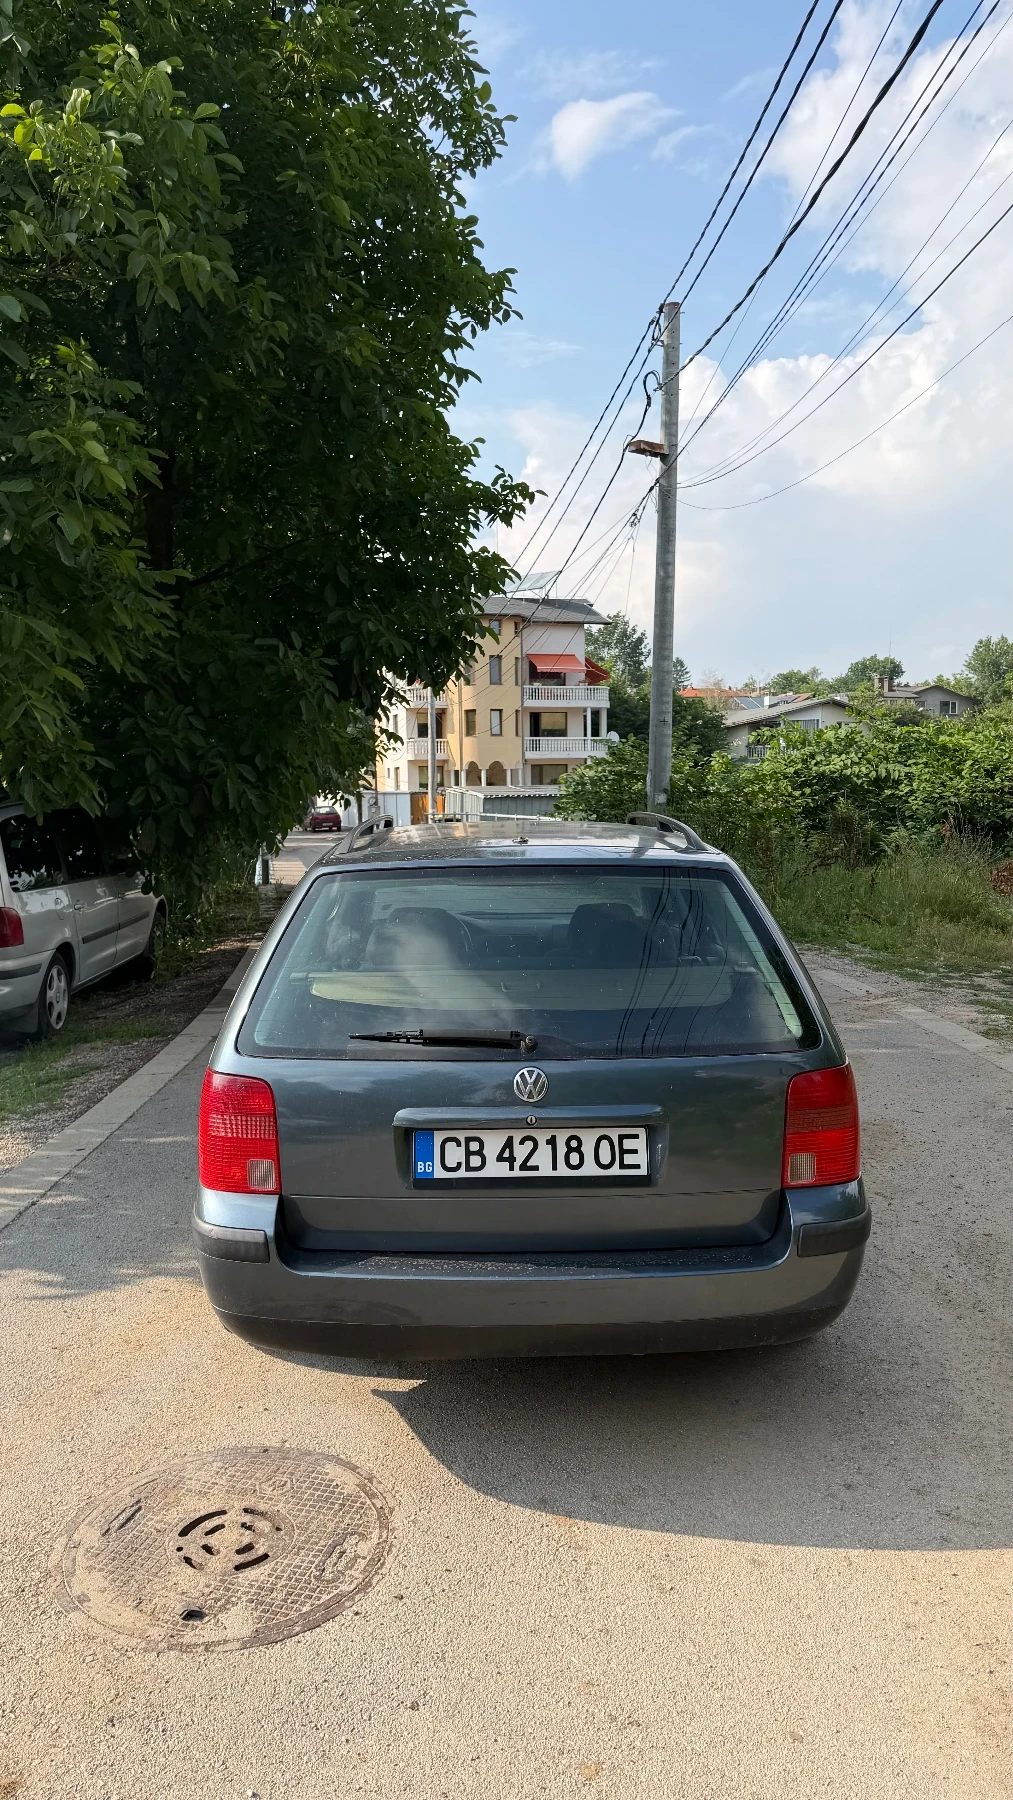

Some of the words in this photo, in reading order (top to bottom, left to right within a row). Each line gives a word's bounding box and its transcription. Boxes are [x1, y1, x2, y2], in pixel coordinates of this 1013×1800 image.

[440, 1136, 486, 1172] CB
[496, 1134, 585, 1171] 4218
[594, 1133, 641, 1170] OE
[417, 1161, 433, 1173] BG
